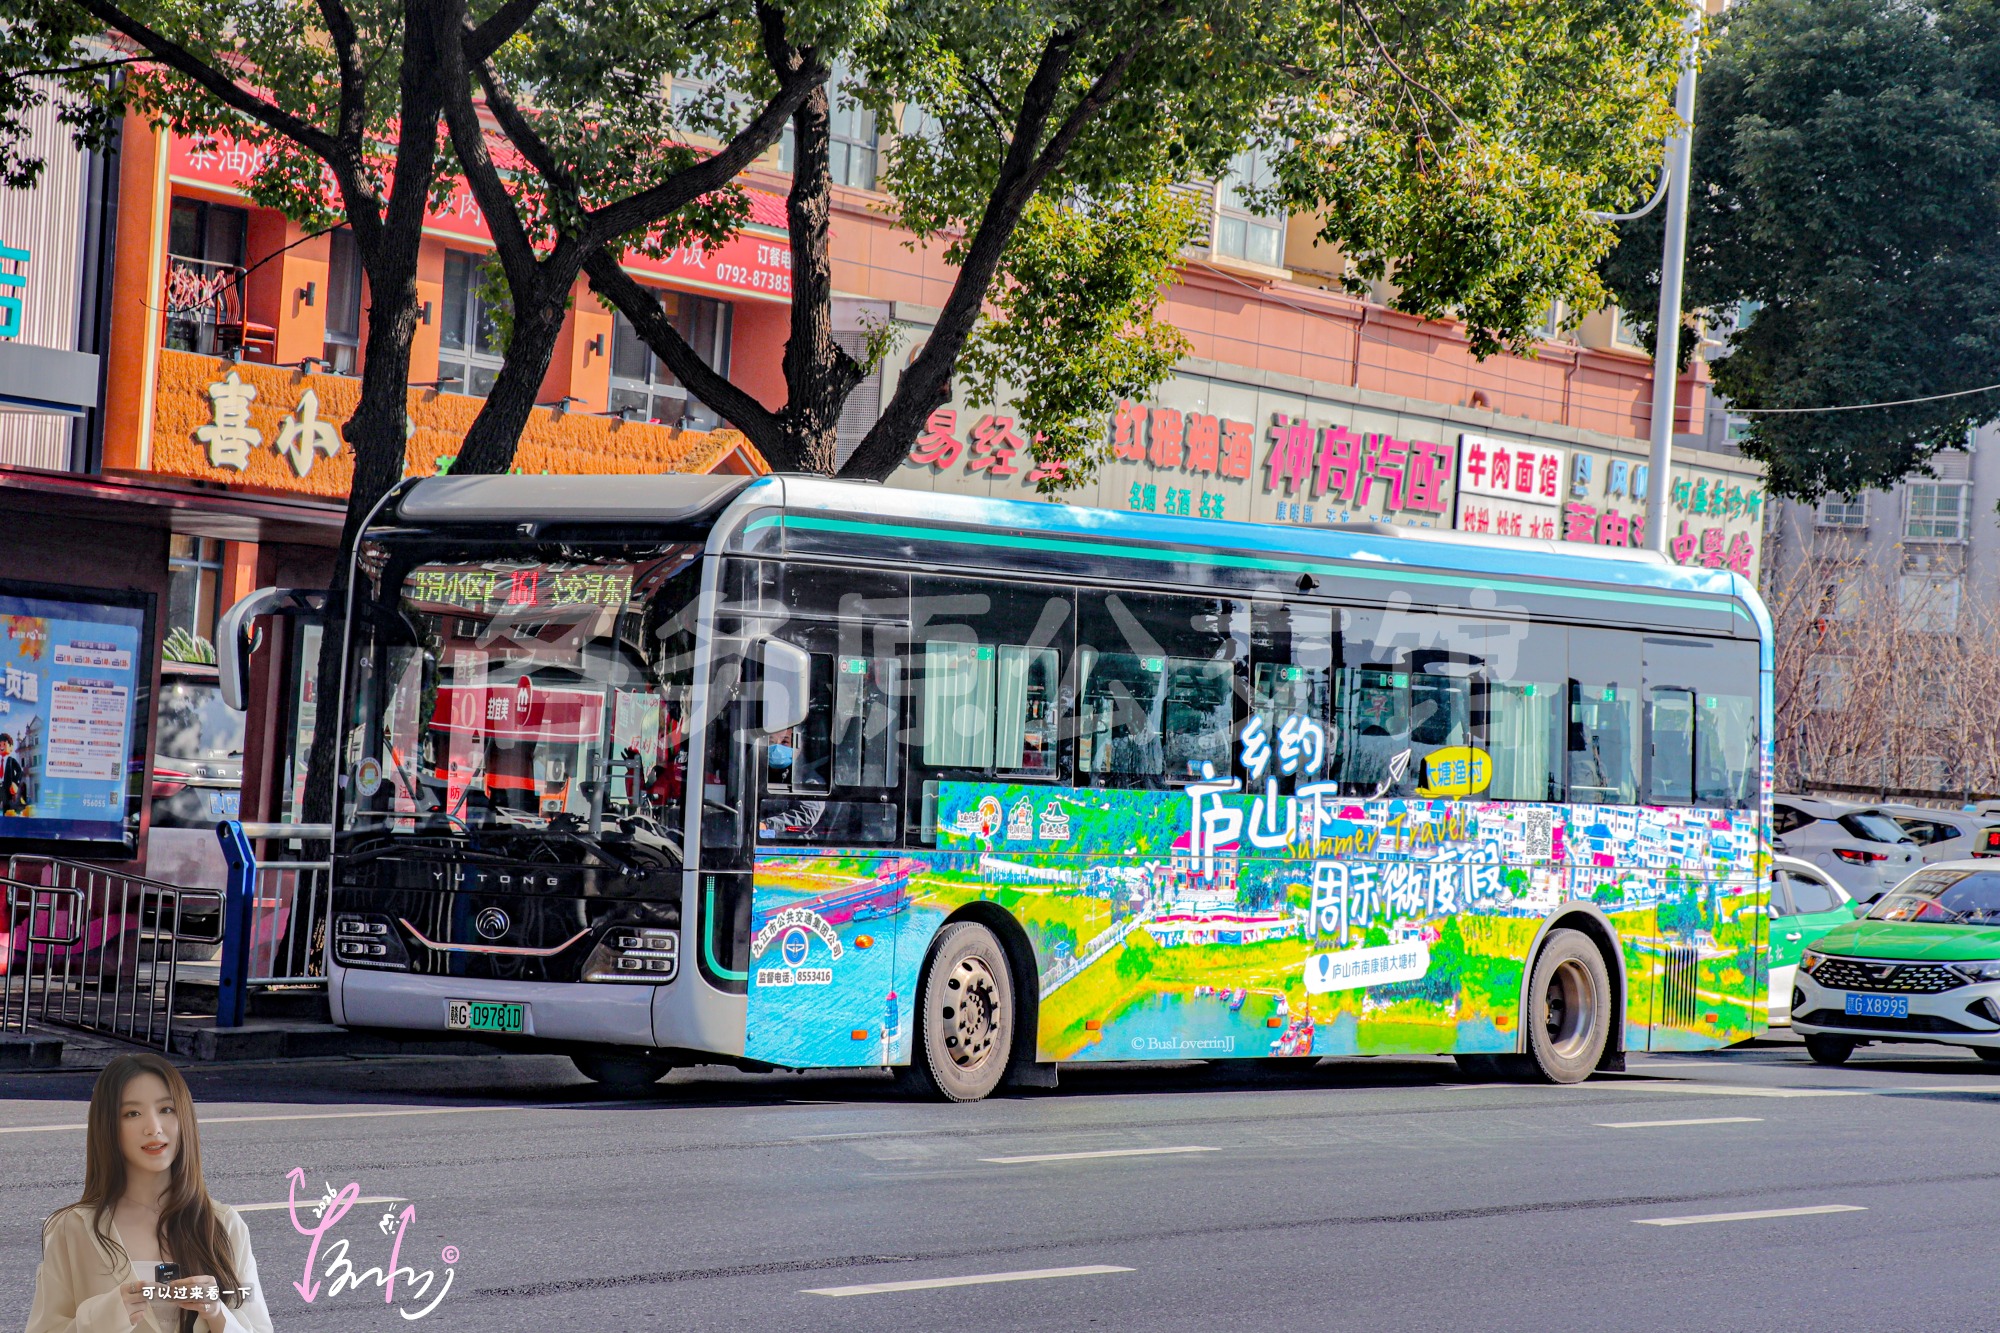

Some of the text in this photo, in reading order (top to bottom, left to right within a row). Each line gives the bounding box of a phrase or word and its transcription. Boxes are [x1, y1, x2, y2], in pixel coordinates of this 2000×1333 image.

[716, 263, 791, 292] 0792-87385
[1113, 399, 1255, 480] 红雅烟酒
[1266, 413, 1455, 514] 神舟汽配
[1467, 443, 1558, 498] 牛肉面馆
[1129, 480, 1226, 519] 名烟 名酒 名茶
[508, 570, 539, 606] 161
[1240, 713, 1326, 781] 乡约
[1184, 760, 1338, 882] 庐山下
[1284, 807, 1465, 863] Summer Travel
[433, 872, 559, 886] YUTONG
[1309, 841, 1504, 947] 周末微度假
[753, 910, 843, 958] 九江市公共交通集团公司
[1332, 951, 1418, 980] 庐山市南康镇大塘村
